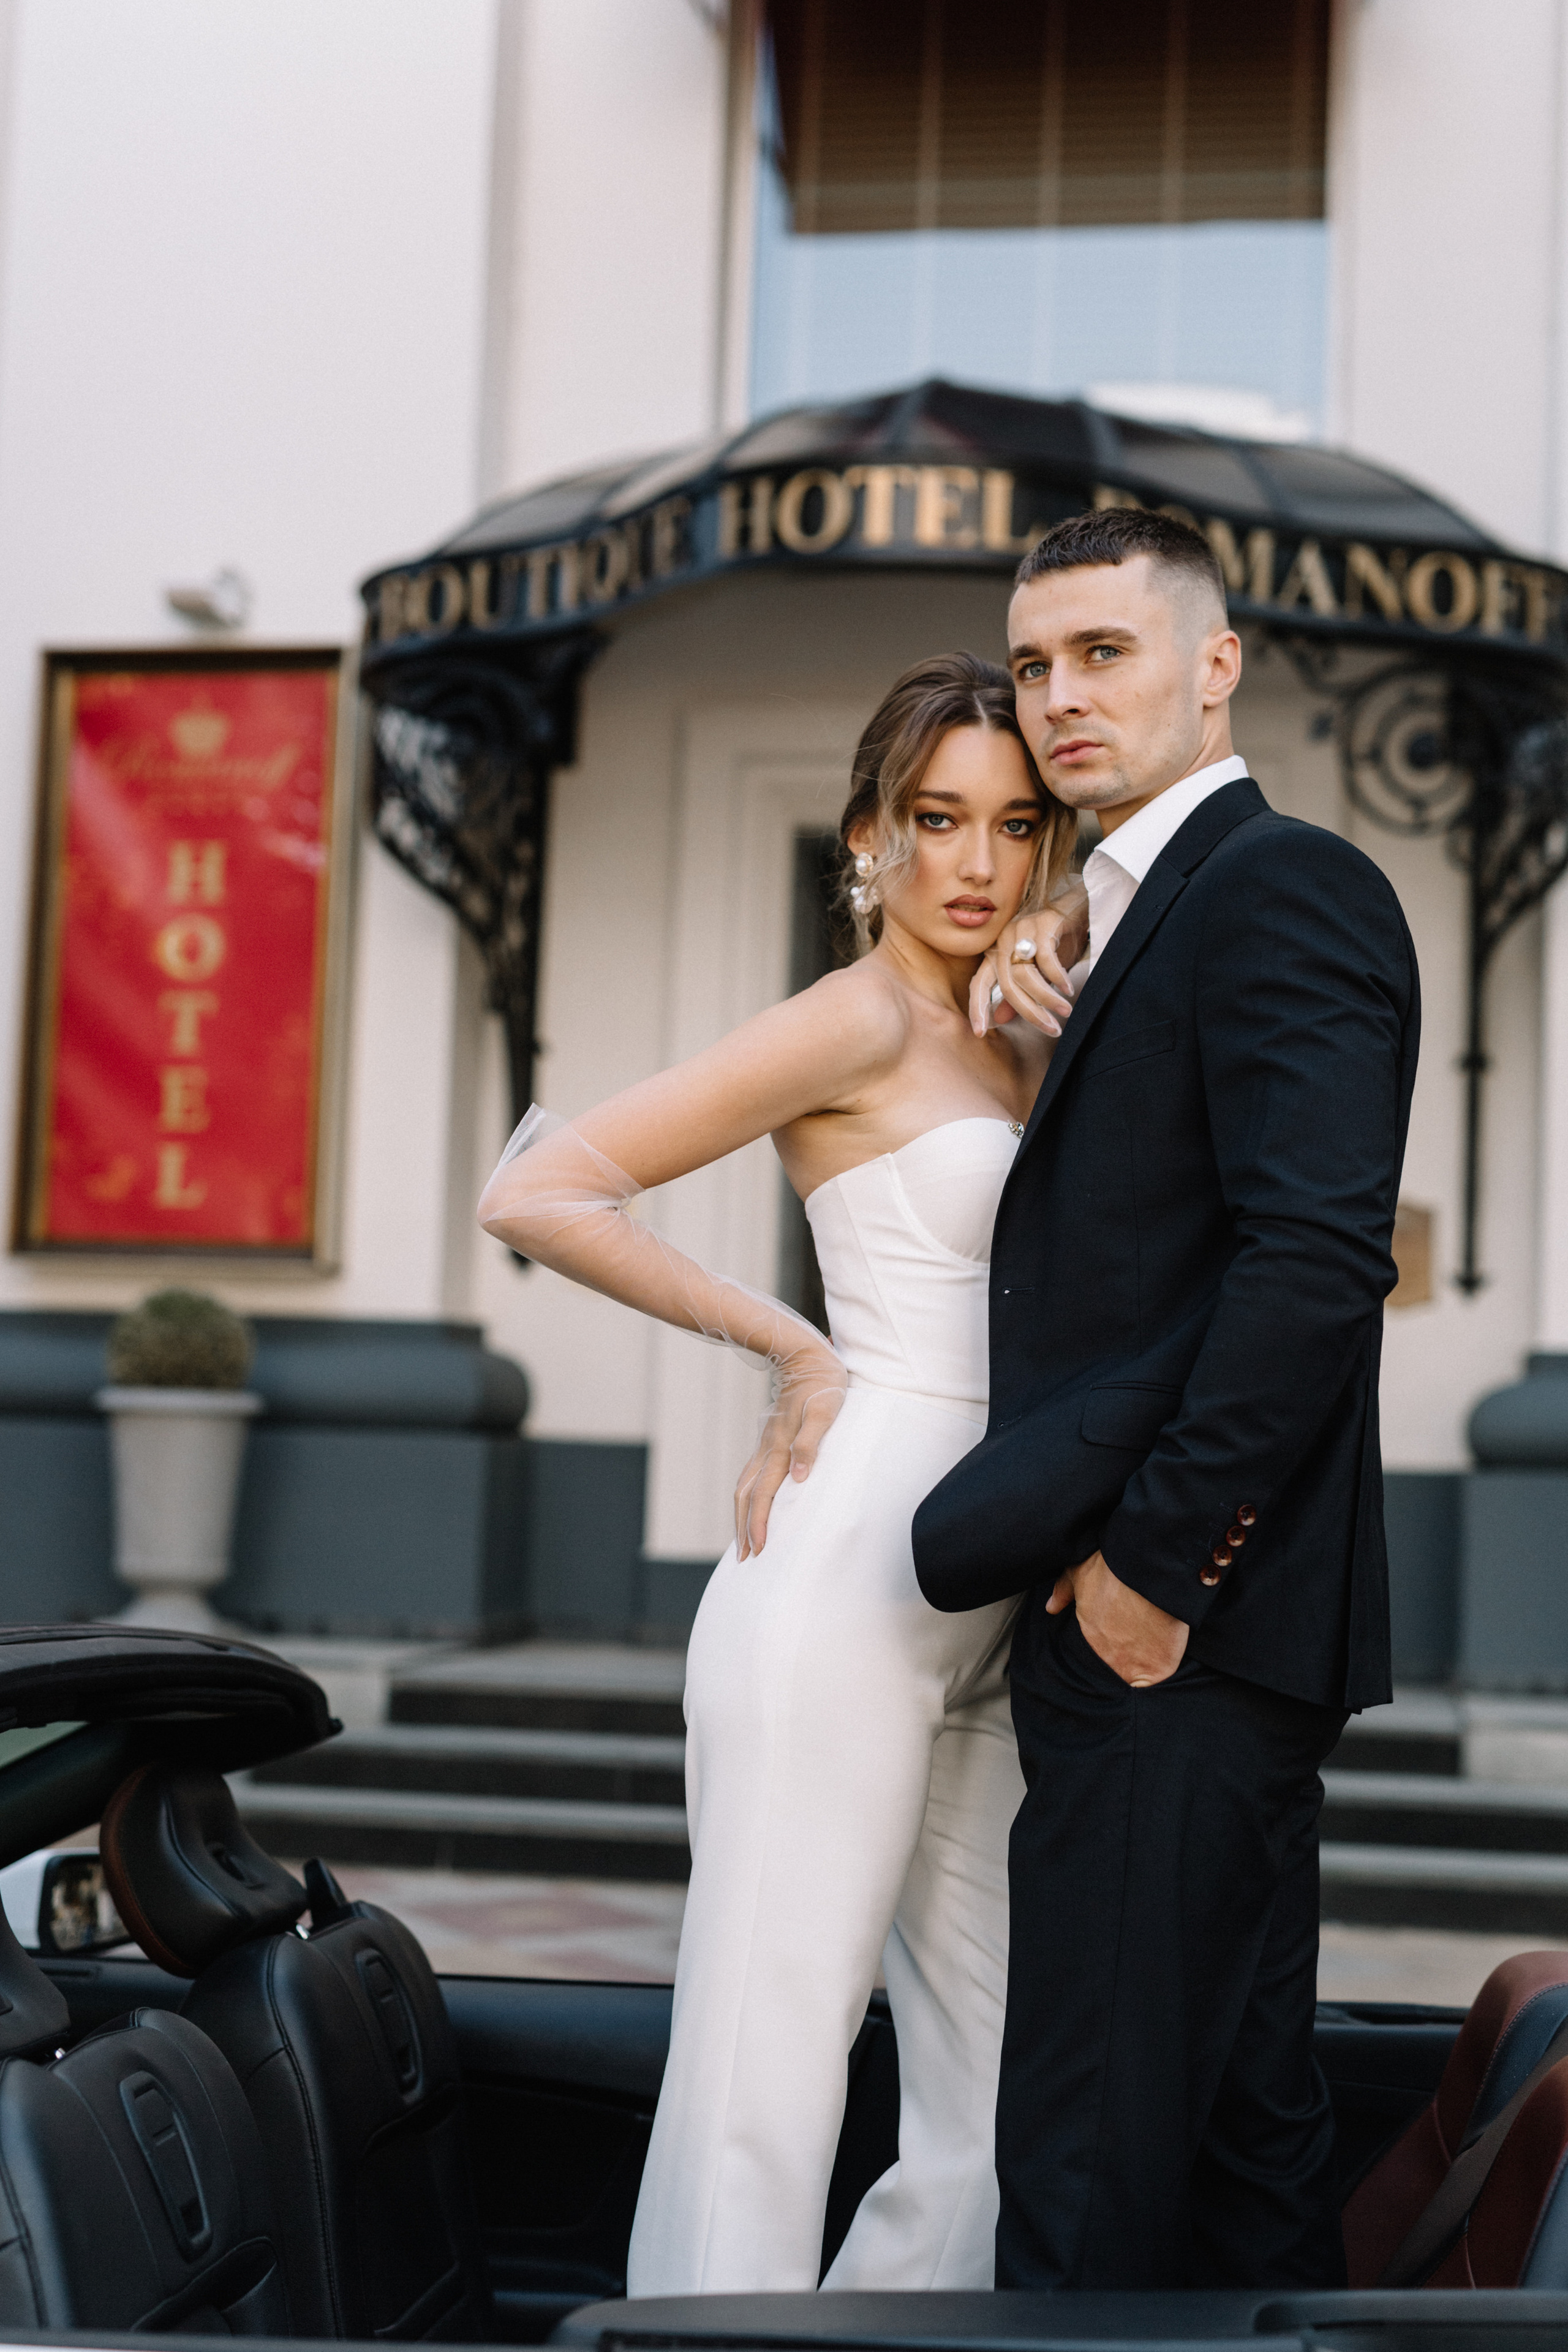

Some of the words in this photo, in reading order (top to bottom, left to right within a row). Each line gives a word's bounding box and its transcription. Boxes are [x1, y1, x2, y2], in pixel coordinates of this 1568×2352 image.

[718, 464, 1047, 556] HOTEL
[1092, 485, 1568, 646] MANOFF
[154, 838, 227, 1210] HOTEL
